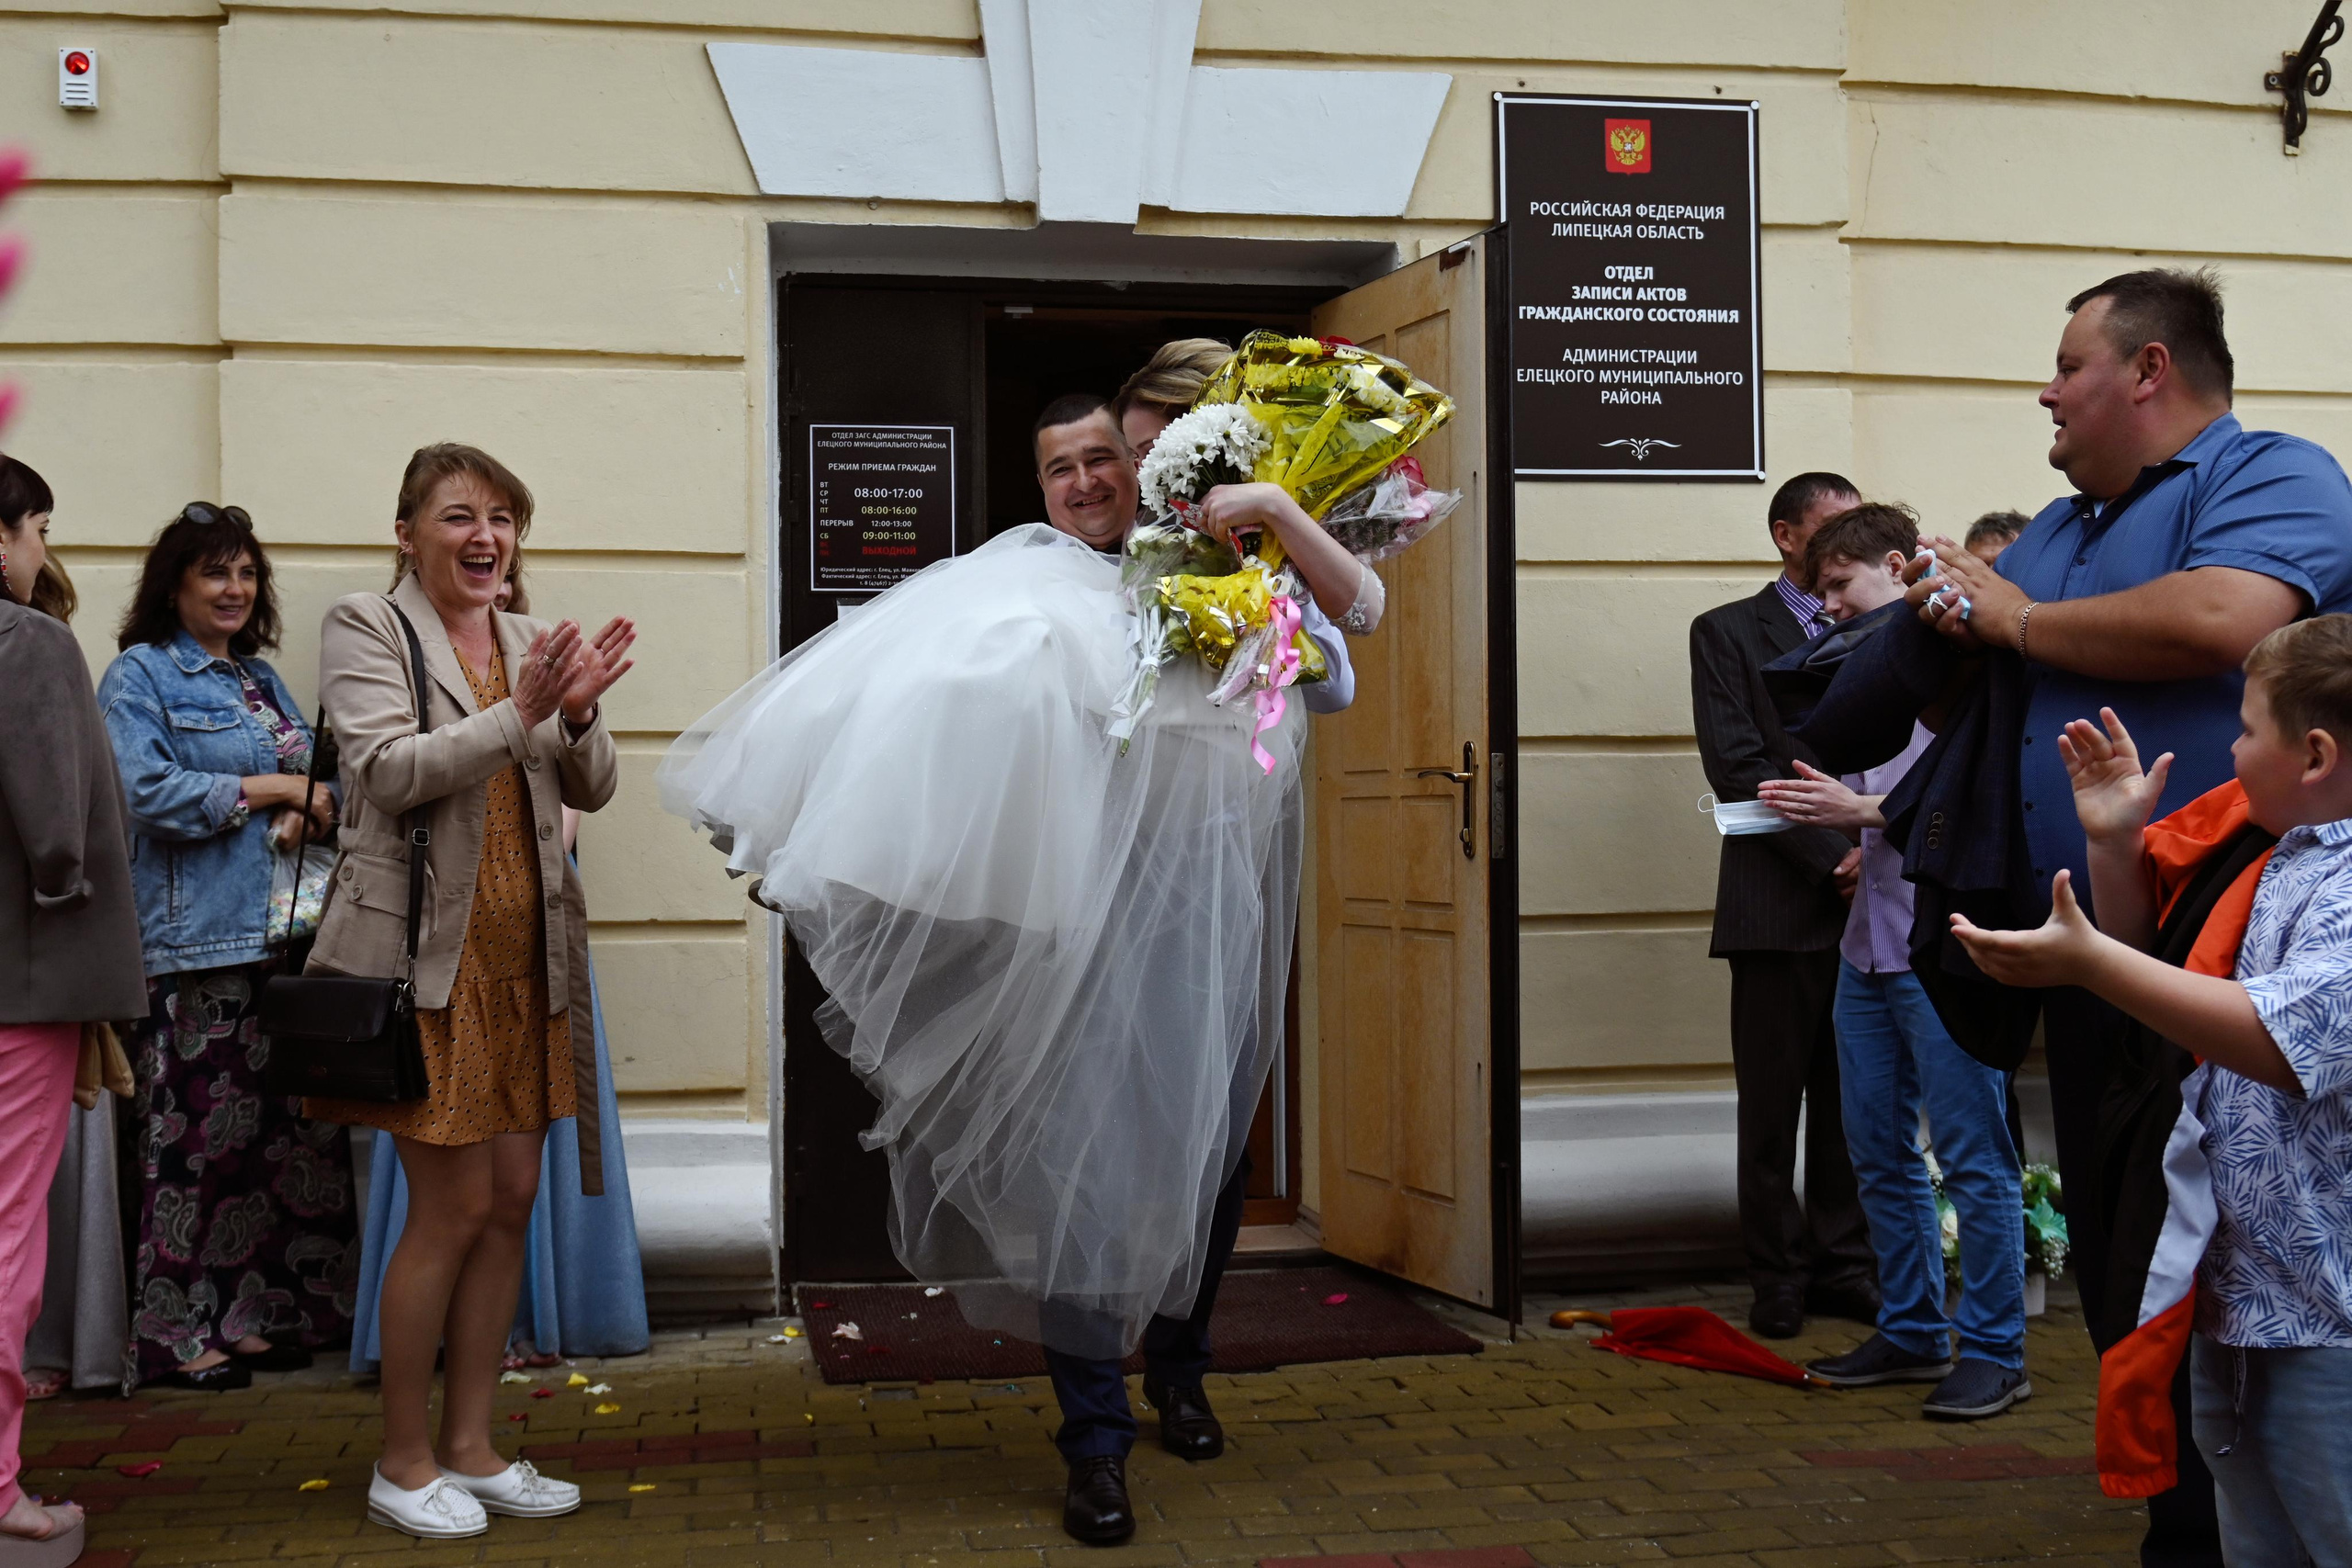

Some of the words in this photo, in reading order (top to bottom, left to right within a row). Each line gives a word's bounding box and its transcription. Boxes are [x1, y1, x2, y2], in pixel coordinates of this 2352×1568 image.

[1530, 200, 1632, 218] РОССИЙСКАЯ
[1635, 203, 1724, 221] ФЕДЕРАЦИЯ
[1551, 223, 1632, 240] ЛИПЕЦКАЯ
[1636, 225, 1704, 240] ОБЛАСТЬ
[1604, 265, 1654, 282] ОТДЕЛ
[1571, 286, 1633, 300] ЗАПИСИ
[1636, 287, 1687, 301] АКТОВ
[1519, 305, 1644, 322] ГРАЖДАНСКОГО
[1647, 308, 1739, 323] СОСТОЯНИЯ
[1562, 348, 1698, 367] АДМИНИСТРАЦИИ
[1516, 368, 1595, 385] ЕЛЕЦКОГО
[1599, 369, 1743, 387] МУНИЦИПАЛЬНОГО
[1600, 388, 1662, 404] РАЙОНА
[897, 464, 936, 472] ГРАЖДАН
[854, 488, 923, 498] 08:00-17:00
[861, 506, 917, 515] 08:00-16:00
[863, 532, 916, 540] 09:00-11:00
[862, 546, 916, 556] ВЫХОДНОЙ
